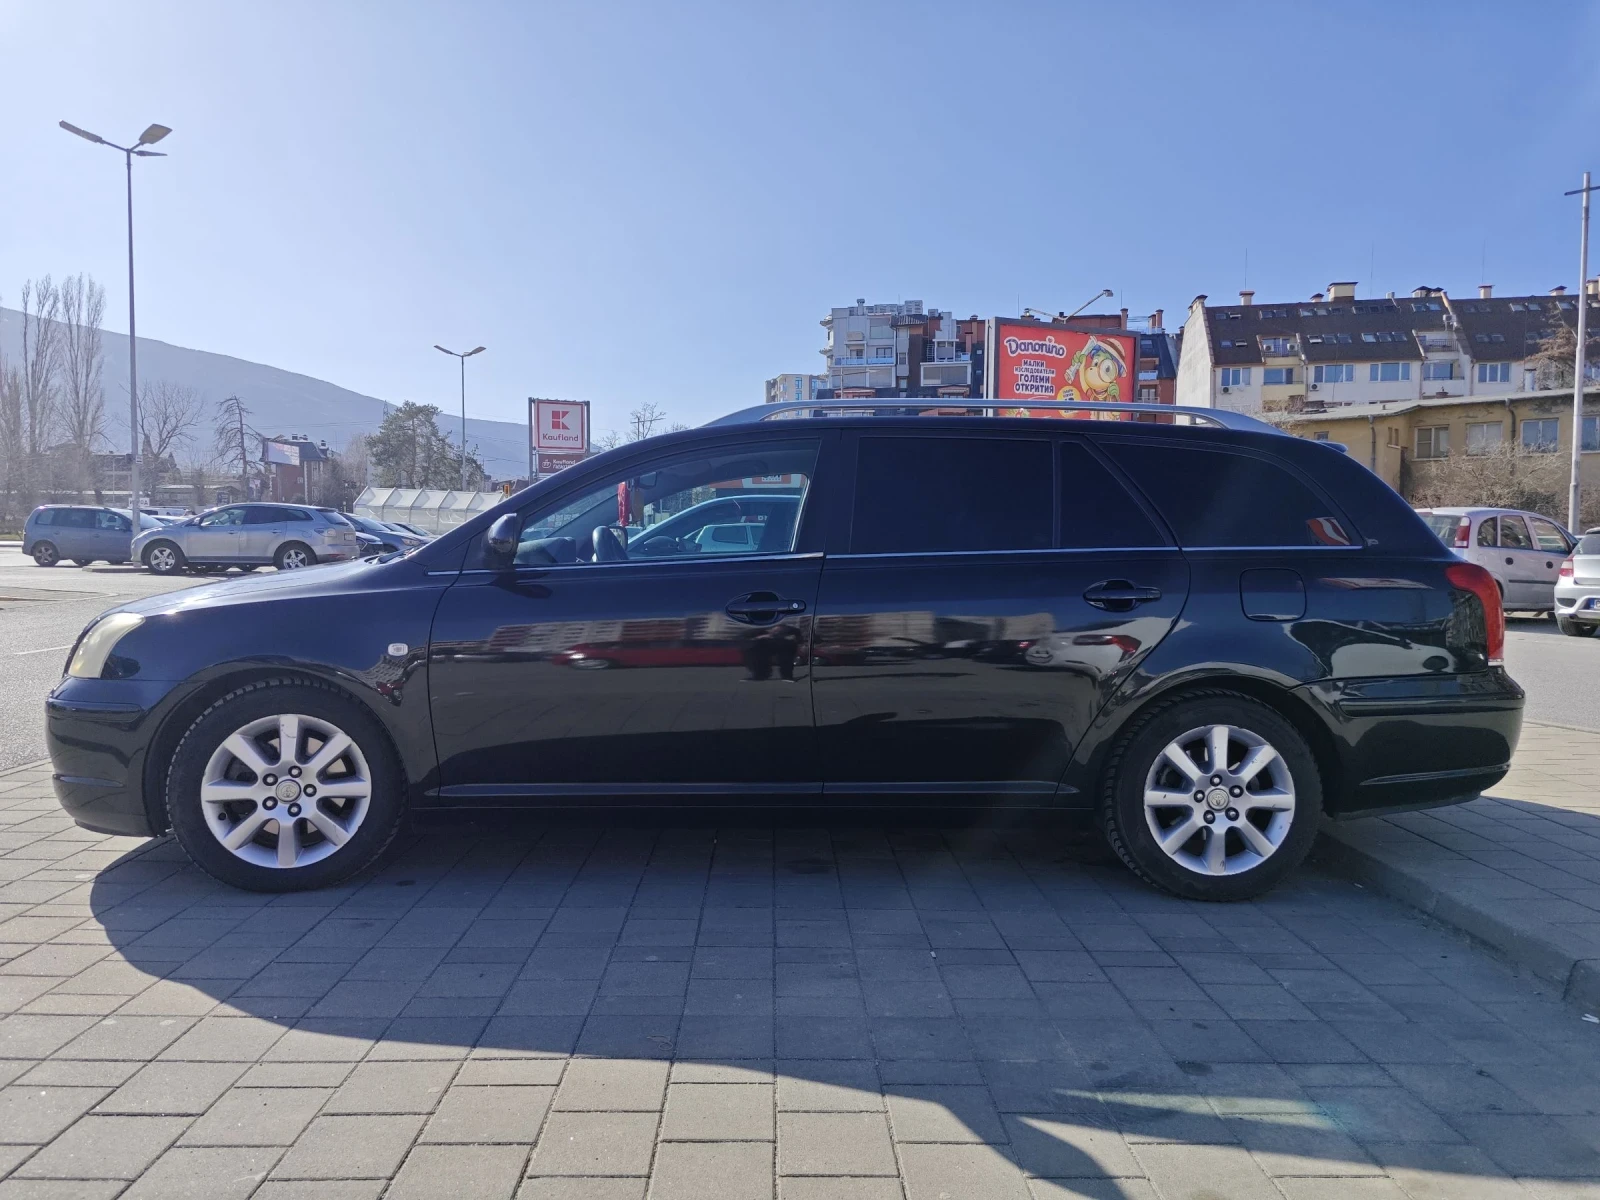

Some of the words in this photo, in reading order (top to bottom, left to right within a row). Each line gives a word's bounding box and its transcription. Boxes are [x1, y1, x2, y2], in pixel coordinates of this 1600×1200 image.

[1006, 338, 1065, 356] Danonino
[1015, 367, 1054, 375] ИЗСЛЕДОВАТЕЛИ
[1020, 374, 1050, 384] ГОЛЕМИ
[1015, 384, 1054, 393] ОТКРИТИЯ
[542, 434, 578, 442] Kaufland
